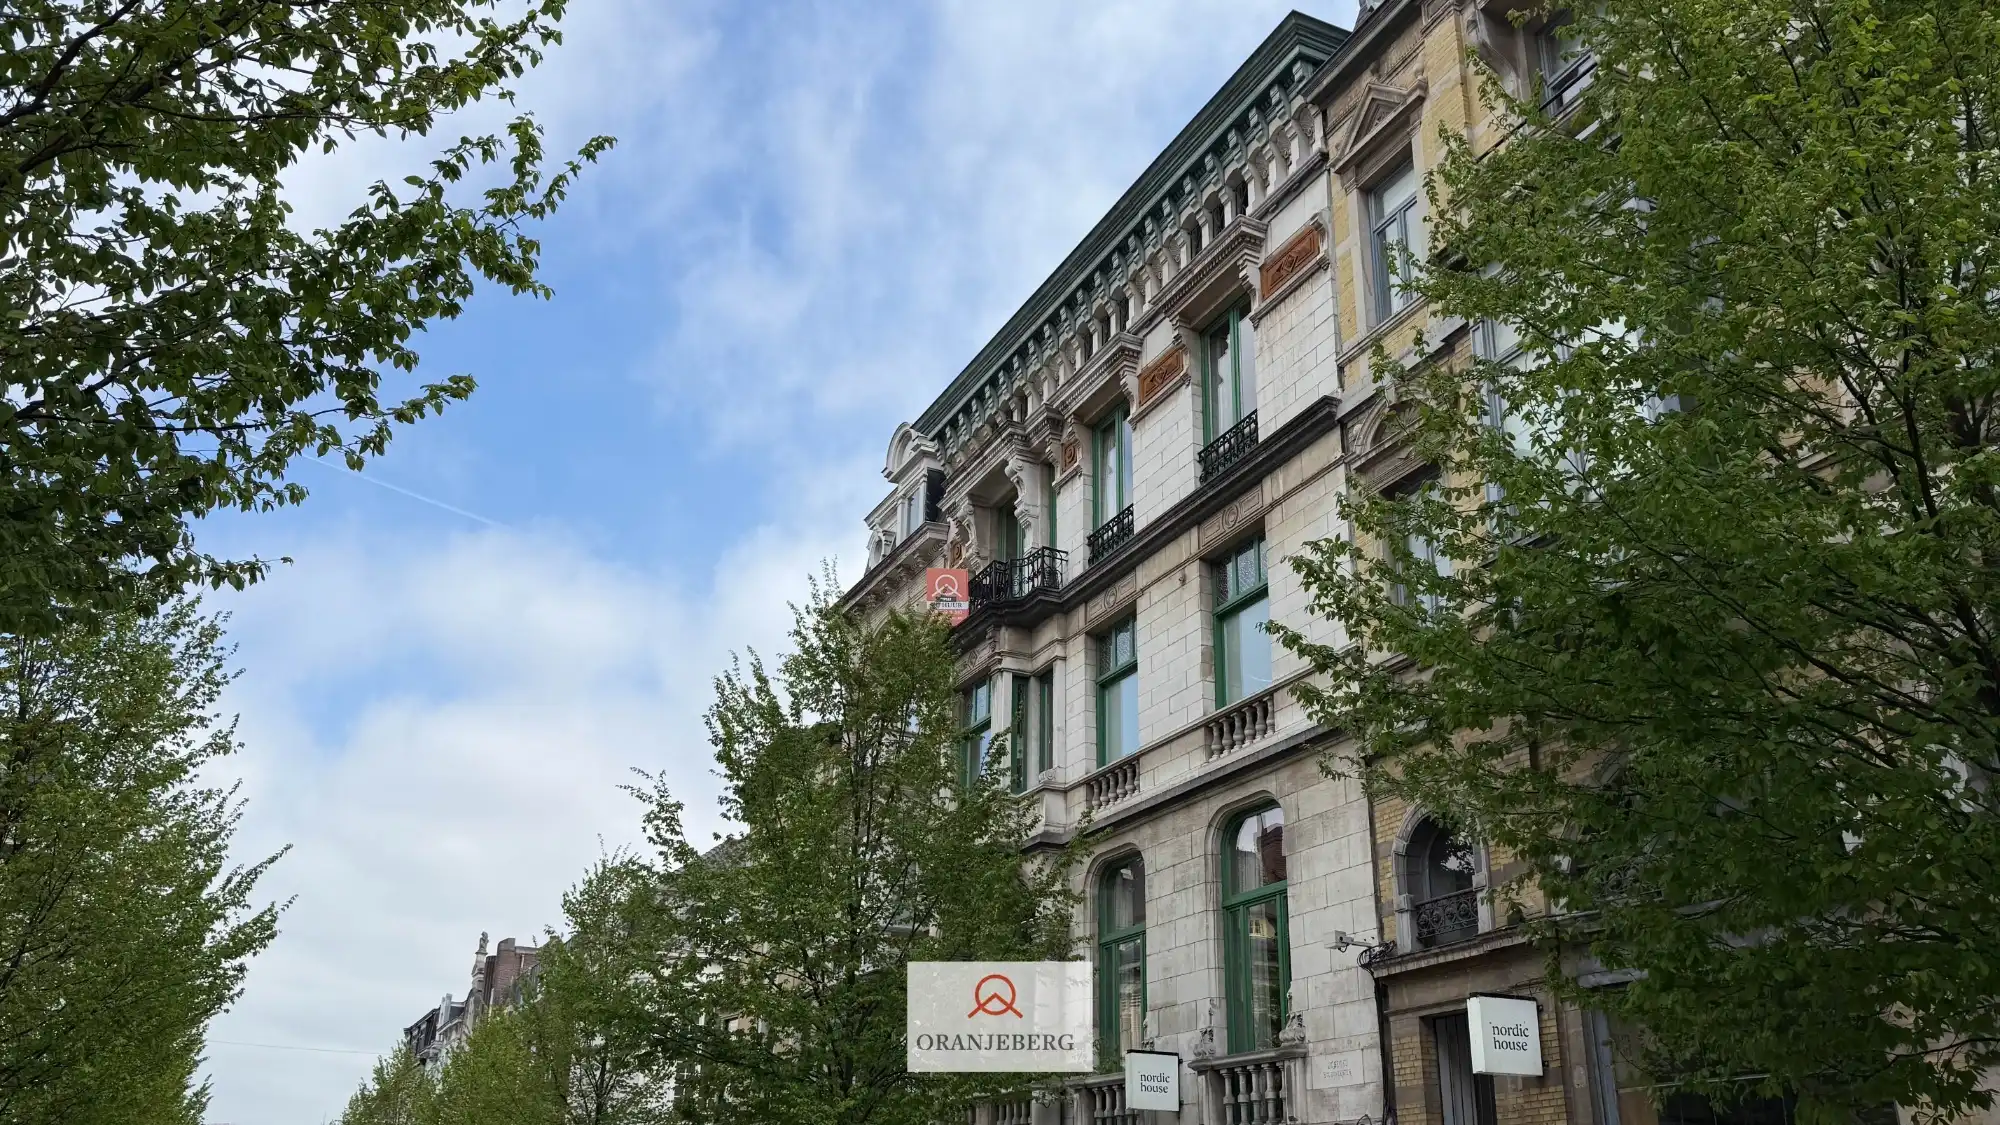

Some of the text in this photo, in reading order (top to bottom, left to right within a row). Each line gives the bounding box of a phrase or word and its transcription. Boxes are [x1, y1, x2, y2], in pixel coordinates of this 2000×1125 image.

[1492, 1024, 1529, 1038] nordic
[1493, 1037, 1528, 1052] house
[1140, 1073, 1170, 1083] nordic
[1140, 1082, 1169, 1093] house
